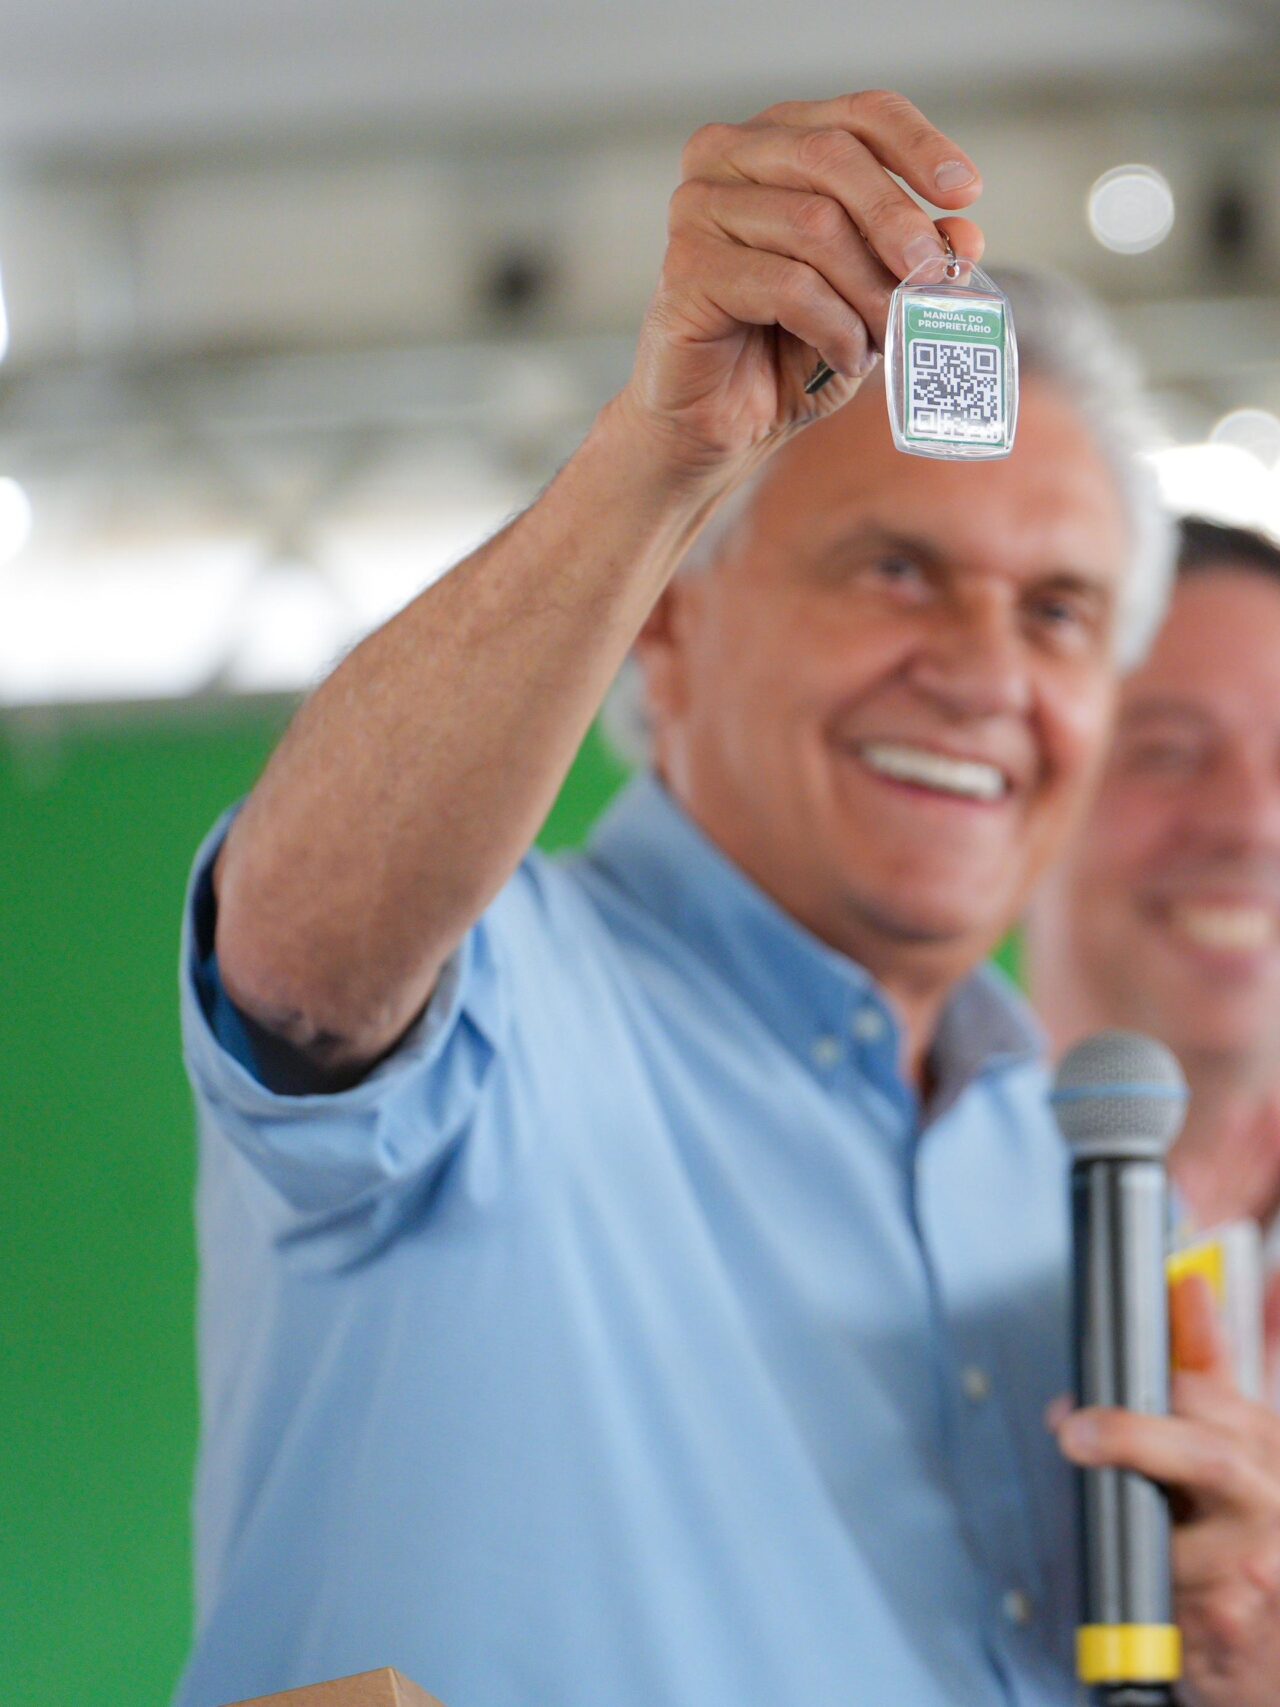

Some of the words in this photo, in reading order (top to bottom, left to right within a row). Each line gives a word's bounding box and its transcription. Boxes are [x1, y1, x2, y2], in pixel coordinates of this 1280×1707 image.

[923, 311, 966, 322] MANUAL
[968, 315, 984, 324] DO
[918, 320, 991, 333] PROPRIETÁRIO
